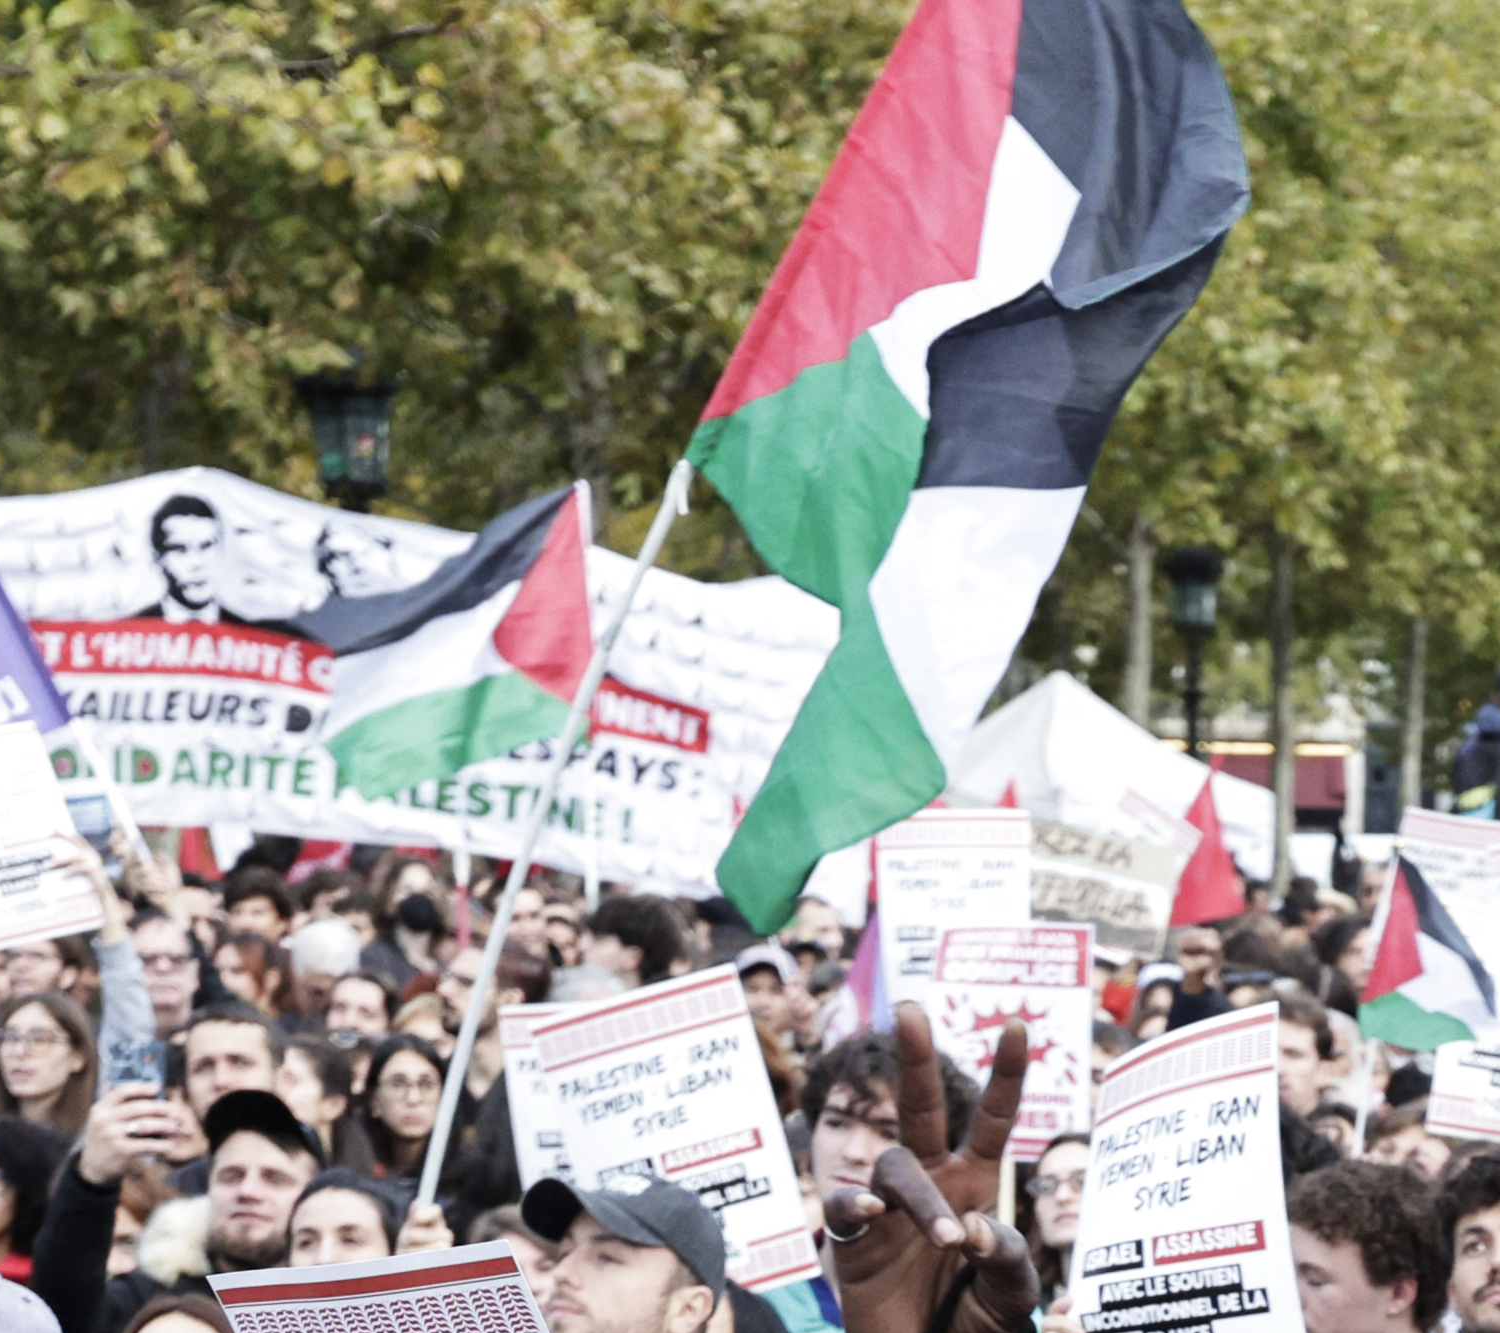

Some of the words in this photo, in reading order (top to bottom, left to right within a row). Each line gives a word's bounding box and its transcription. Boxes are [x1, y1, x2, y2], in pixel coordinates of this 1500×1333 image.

[67, 690, 270, 727] AILLEURS
[560, 1055, 668, 1099] PALESTINE
[689, 1035, 739, 1066] IRAN
[579, 1092, 644, 1124] YEMEN
[665, 1066, 733, 1099] LIBAN
[633, 1106, 690, 1138] SYRIE
[1096, 1108, 1186, 1161] PALESTINE
[1207, 1095, 1261, 1128] IRAN
[1099, 1152, 1153, 1192] YEMEN
[1176, 1133, 1247, 1169] LIBAN
[1134, 1178, 1193, 1211] SYRIE
[1087, 1243, 1141, 1273] ISRAEL
[1155, 1224, 1258, 1260] ASSASSINE
[1102, 1278, 1145, 1303] AVEC
[1147, 1275, 1168, 1297] LE
[1169, 1267, 1239, 1294] SOUTIEN
[1087, 1296, 1216, 1333] INCONDITIONNEL
[1218, 1294, 1241, 1314] DE
[1243, 1290, 1268, 1310] LA
